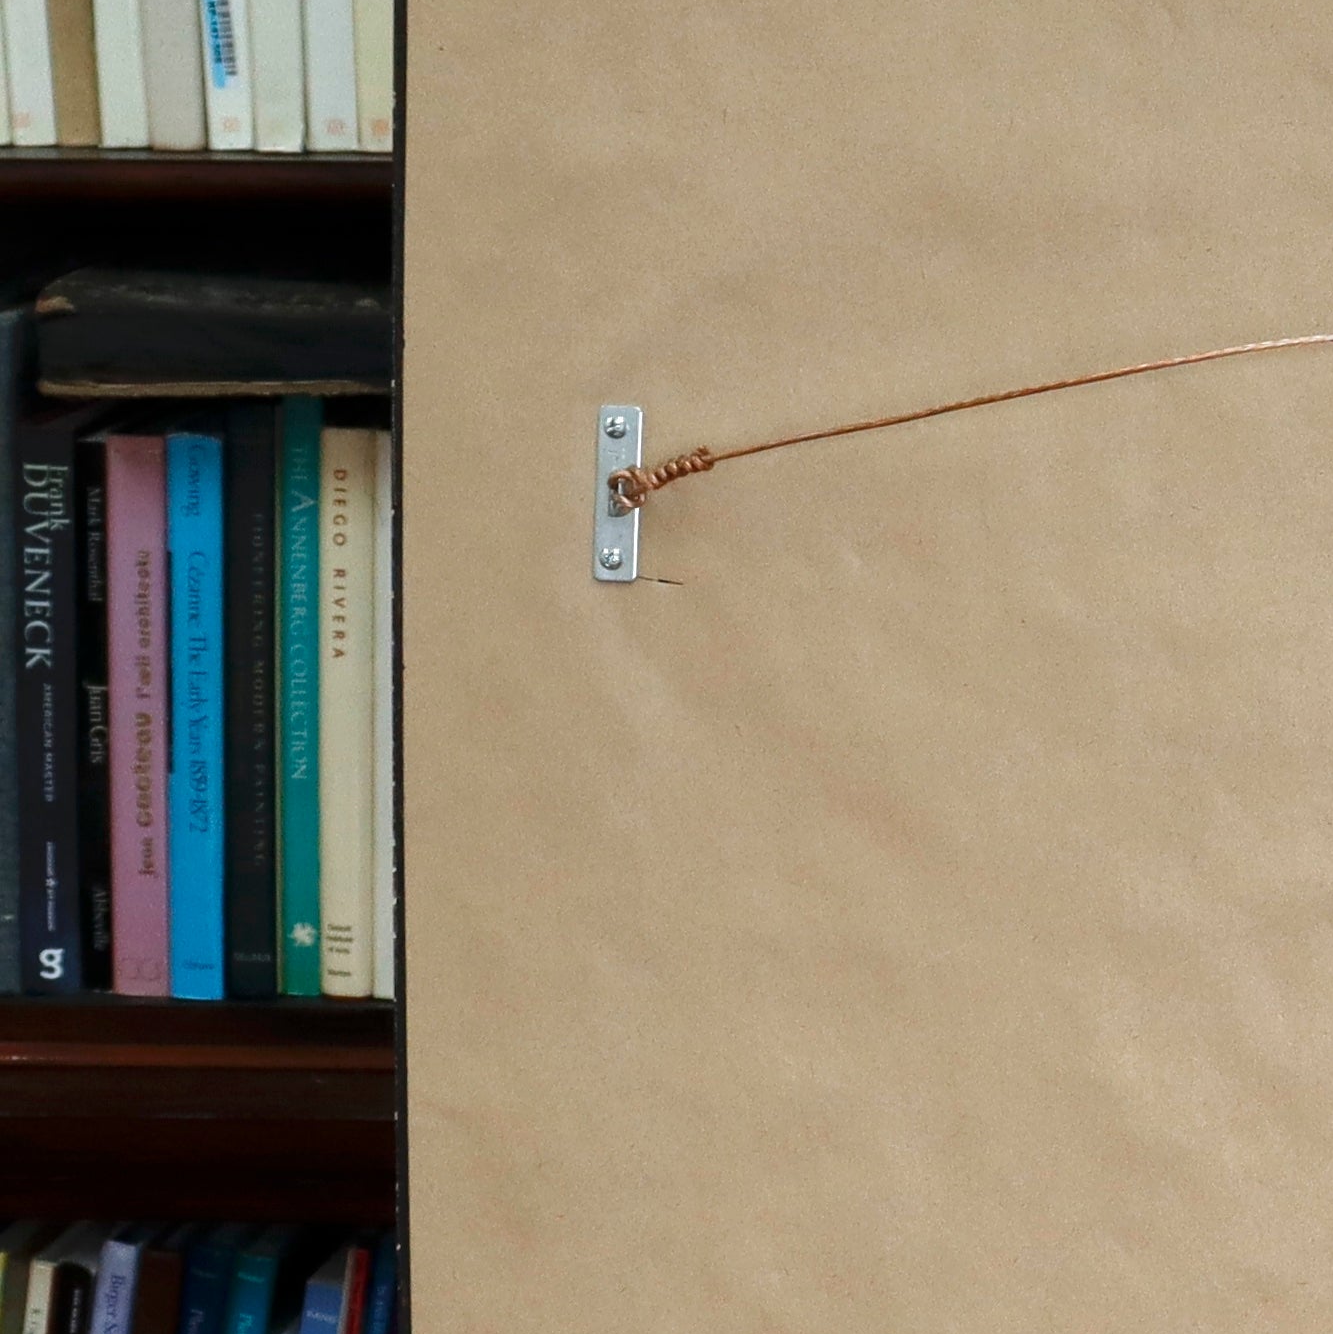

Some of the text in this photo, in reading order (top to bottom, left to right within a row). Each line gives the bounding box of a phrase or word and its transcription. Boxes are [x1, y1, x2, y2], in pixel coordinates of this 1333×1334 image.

[48, 466, 72, 530] Frank
[87, 487, 104, 602] Mark Rosenthal
[23, 462, 53, 668] DUVENECK
[290, 490, 318, 636] ANNENBERG
[332, 469, 347, 660] DIEGO RIVERA
[188, 634, 209, 664] The
[82, 681, 108, 764] Juan Gris
[290, 645, 309, 781] COLLECTION
[90, 886, 109, 951] Abbeville
